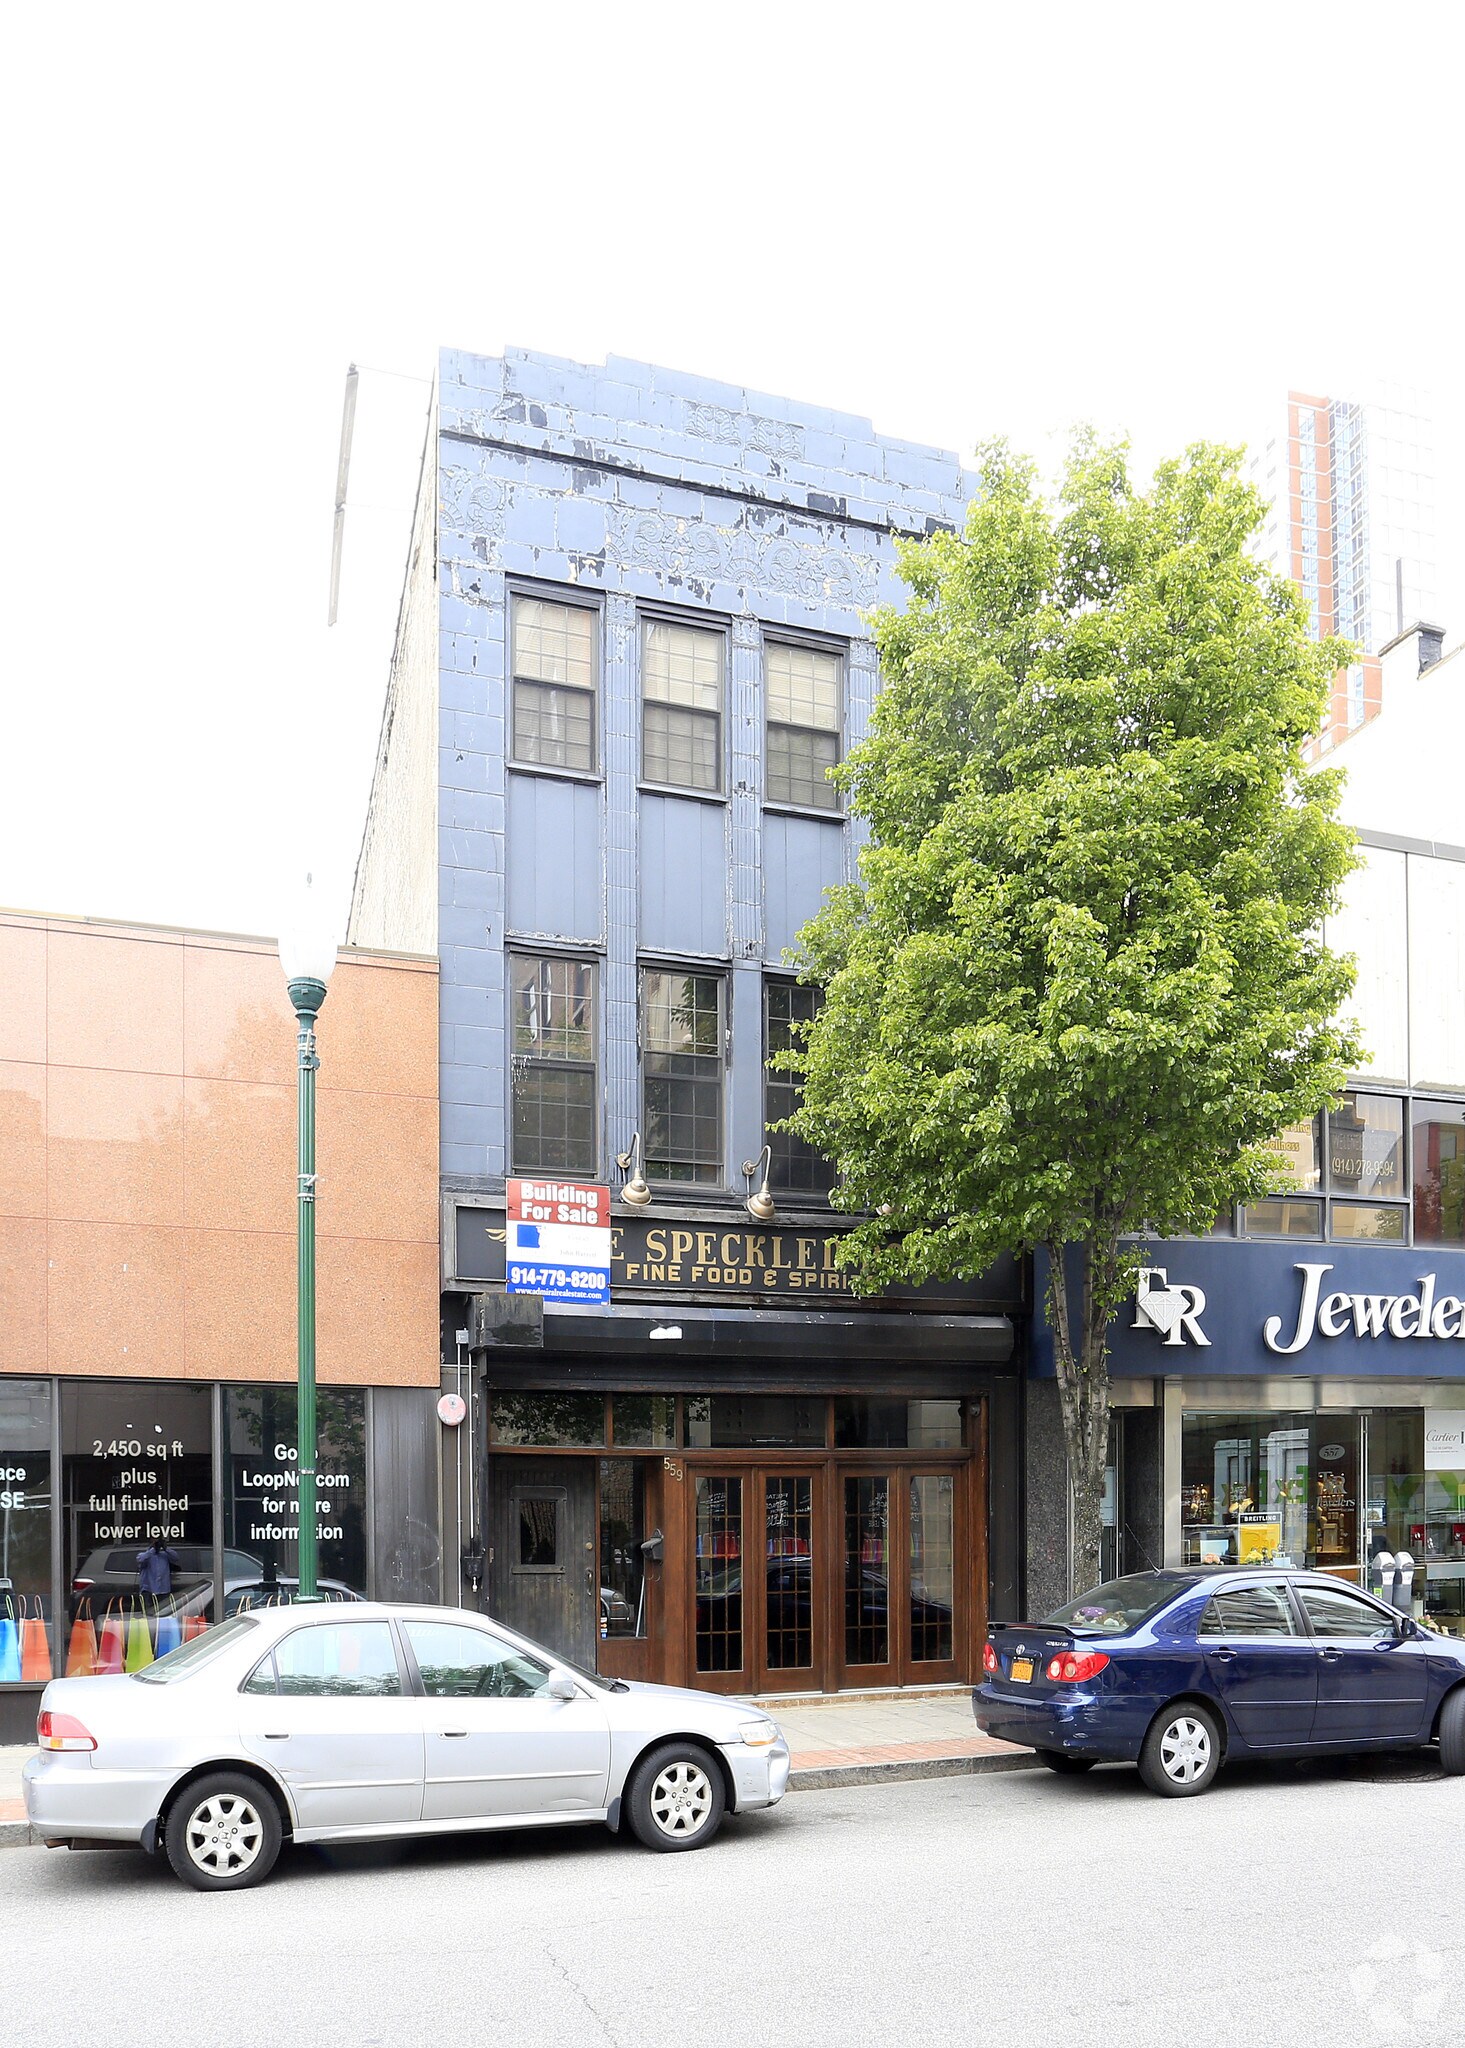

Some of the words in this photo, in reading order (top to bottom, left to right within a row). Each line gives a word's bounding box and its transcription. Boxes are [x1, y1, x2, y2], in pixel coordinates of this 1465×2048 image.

[1332, 1157, 1354, 1175] (914)
[521, 1182, 598, 1209] Building
[521, 1202, 552, 1220] For
[557, 1204, 598, 1225] Sale
[511, 1266, 606, 1290] 914-779-8200
[626, 1263, 681, 1281] FINE
[691, 1266, 752, 1285] FOOD
[515, 1287, 602, 1299] www.admiralrealestate.com
[1426, 1429, 1459, 1442] Cartier
[146, 1444, 167, 1460] sq
[171, 1441, 183, 1457] ft
[274, 1443, 298, 1461] Go
[1323, 1447, 1340, 1457] 557
[121, 1468, 157, 1488] plus
[664, 1457, 683, 1481] 559
[242, 1470, 350, 1491] LoopNcom
[89, 1495, 116, 1511] full
[121, 1494, 189, 1511] finished
[262, 1497, 286, 1513] for
[290, 1500, 331, 1514] mre
[95, 1522, 141, 1539] lower
[146, 1522, 184, 1538] level
[251, 1523, 343, 1540] informion
